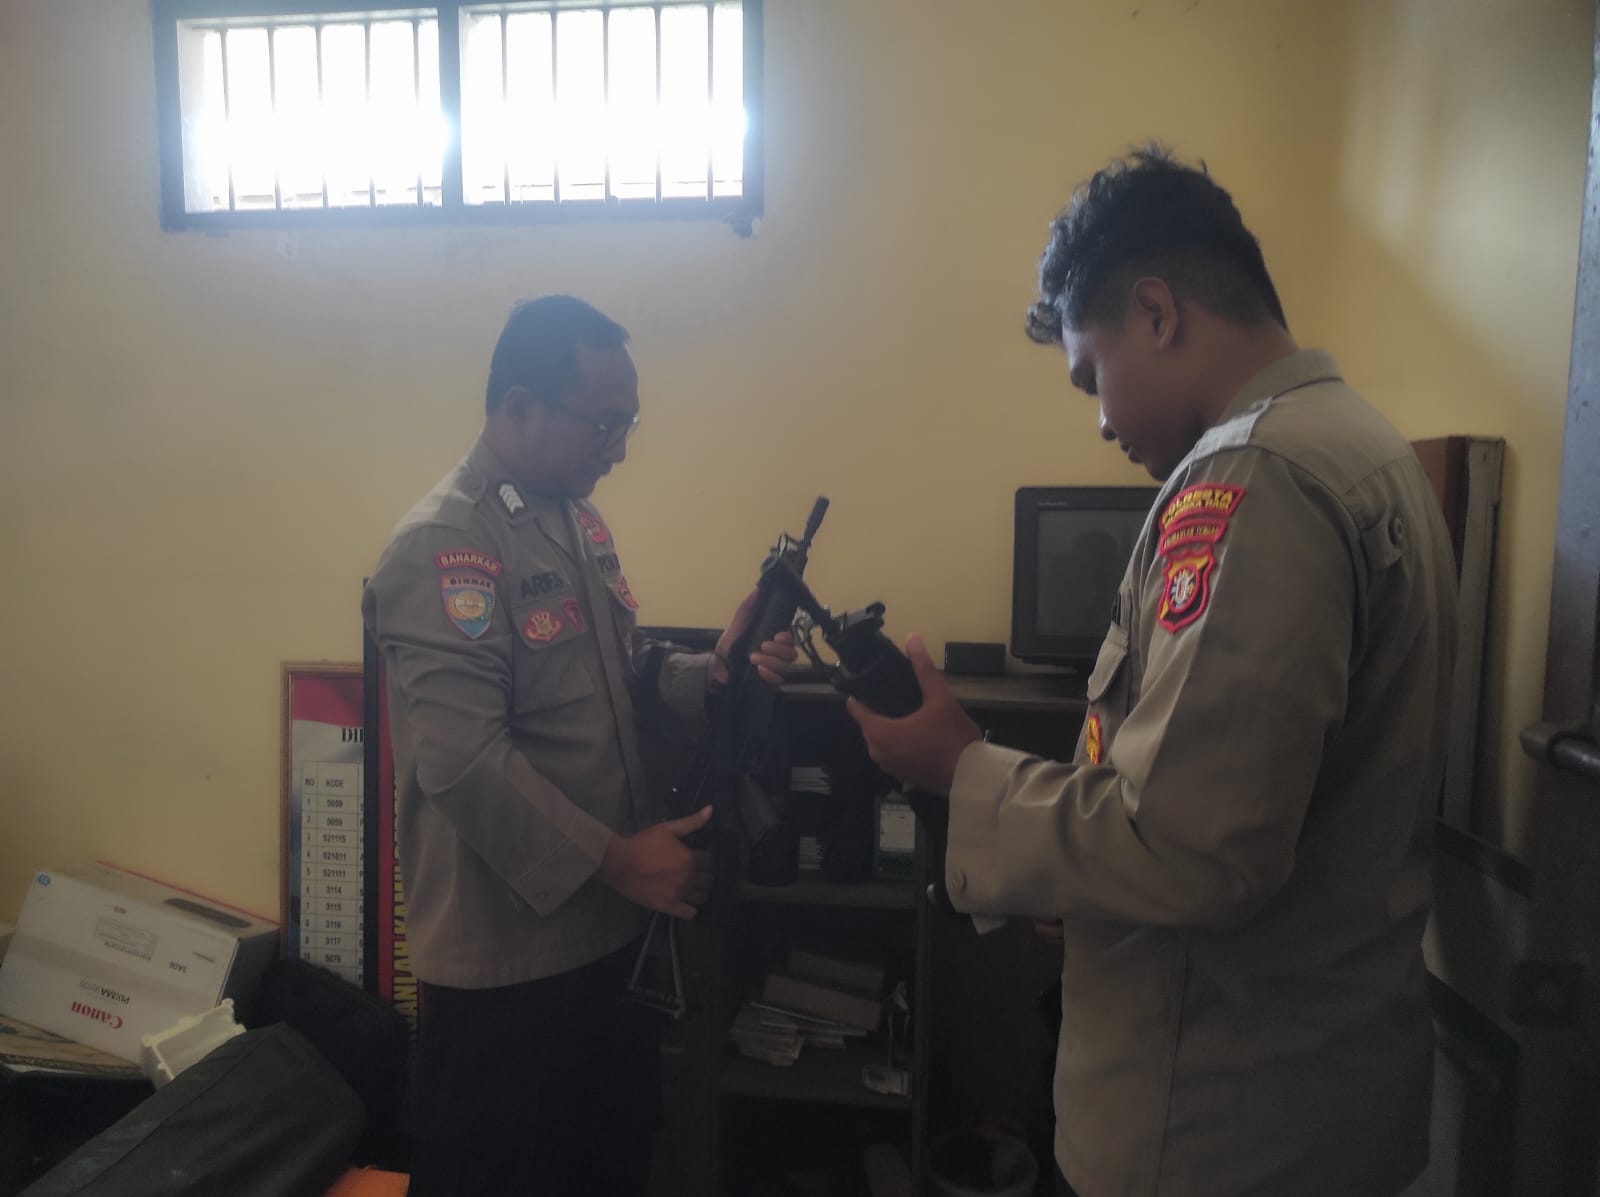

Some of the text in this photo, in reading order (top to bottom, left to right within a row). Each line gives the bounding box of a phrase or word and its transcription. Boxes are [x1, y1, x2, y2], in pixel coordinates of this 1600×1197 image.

[305, 778, 344, 787] NO KODE
[71, 1001, 123, 1029] Canon
